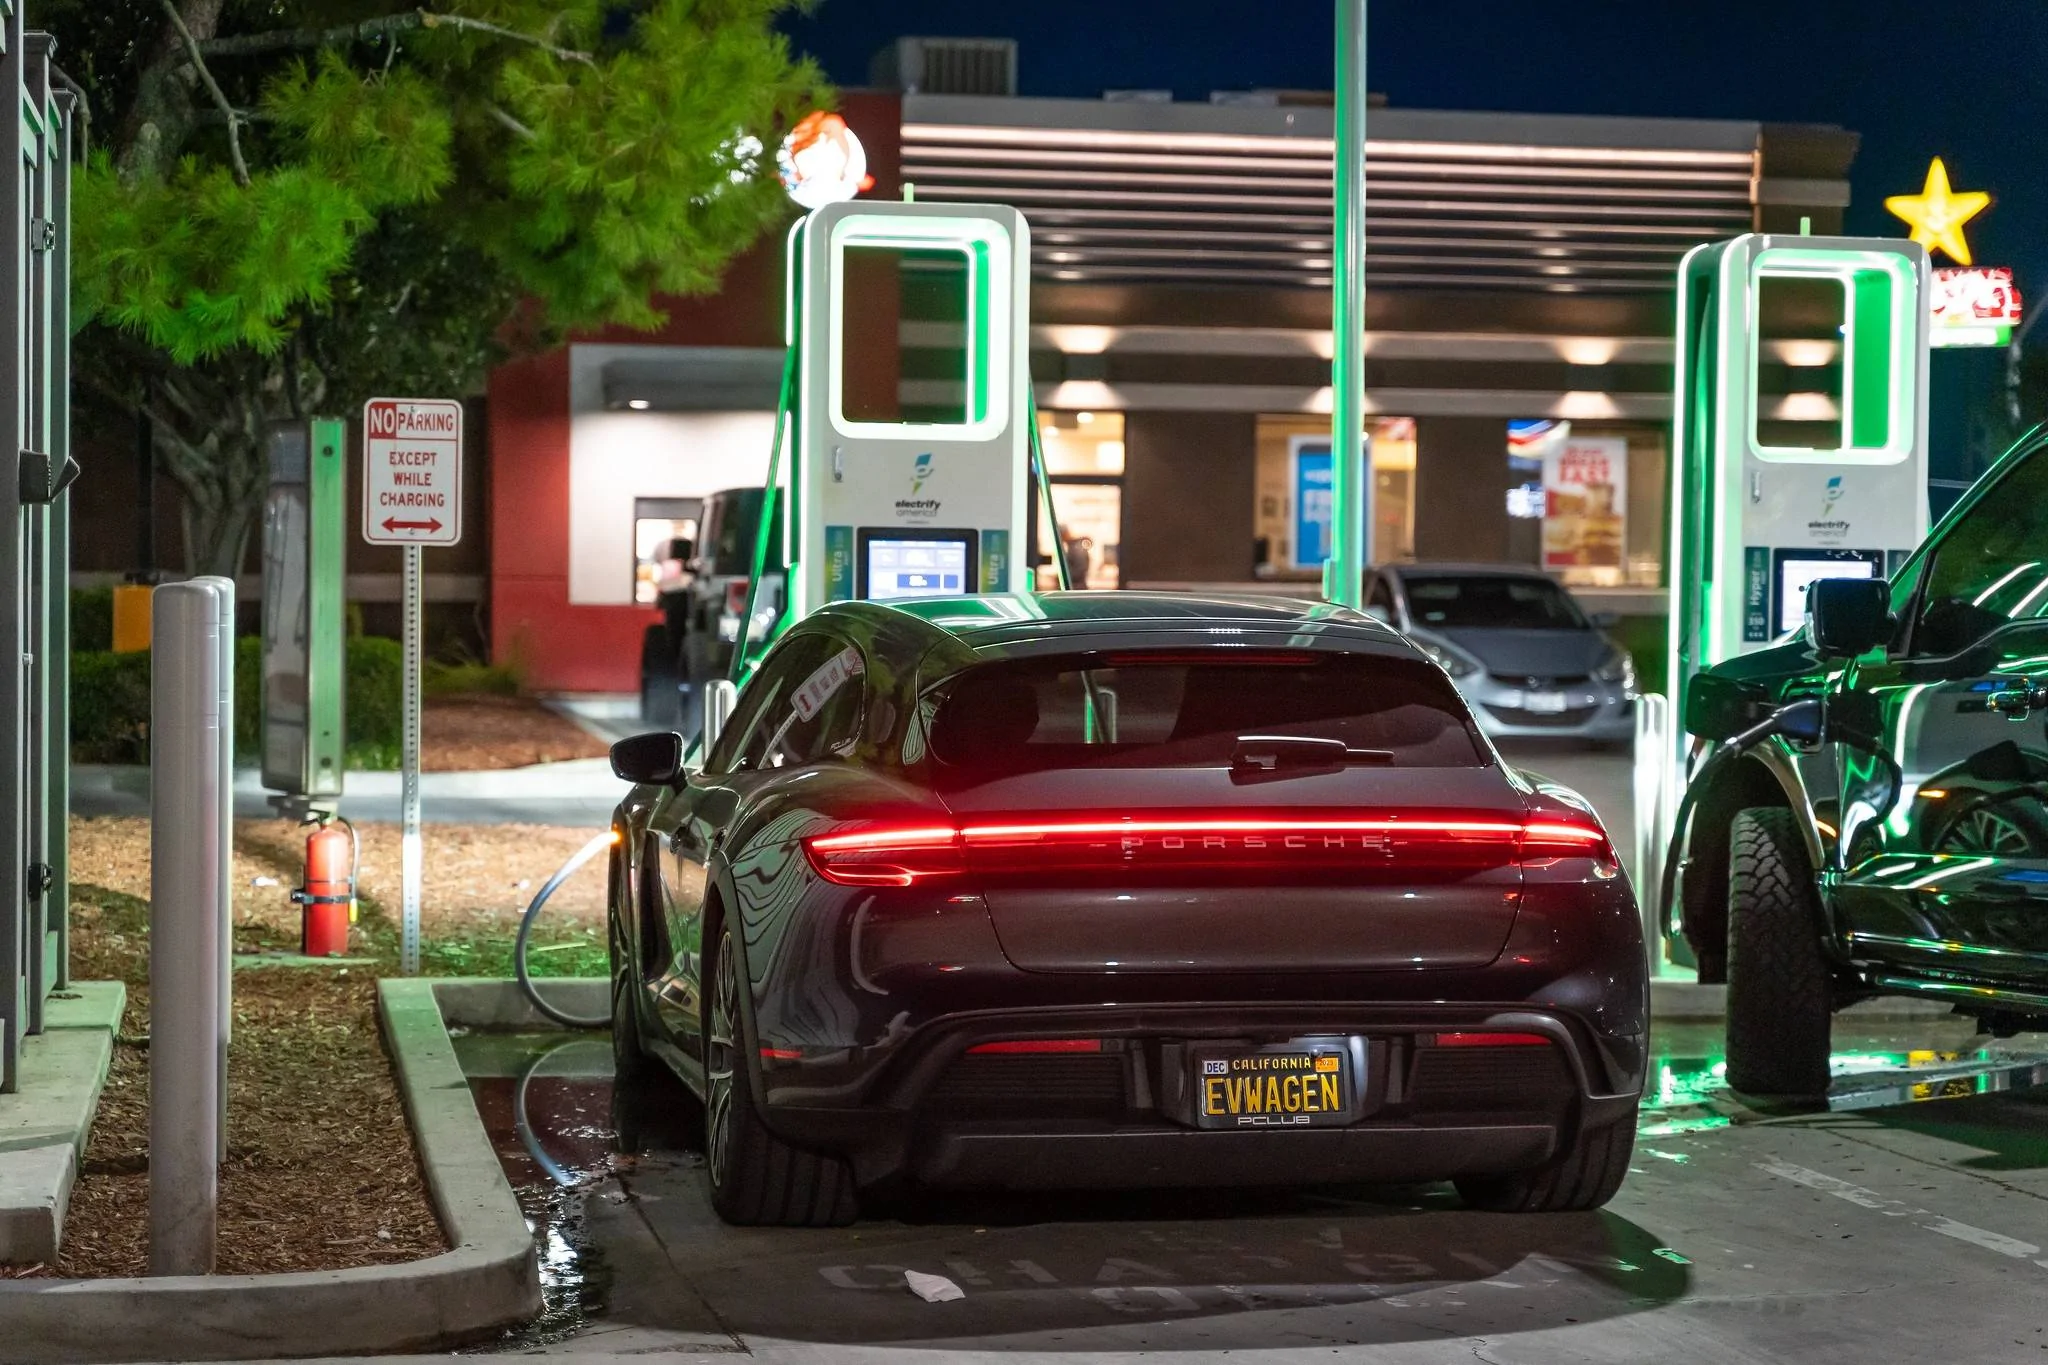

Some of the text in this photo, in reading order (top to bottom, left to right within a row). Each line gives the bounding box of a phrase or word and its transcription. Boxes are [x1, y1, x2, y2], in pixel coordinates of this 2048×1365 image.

[370, 407, 454, 434] NO PARKING
[389, 451, 438, 466] EXCEPT
[393, 472, 432, 487] WHILE
[379, 492, 445, 507] CHARGING
[895, 499, 941, 511] electrify
[1808, 520, 1850, 530] electrify
[1121, 835, 1385, 850] PORSCHE
[1206, 1062, 1226, 1073] DEC
[1232, 1057, 1312, 1071] CALIFORNIA
[1205, 1074, 1340, 1116] EVWAGEN
[1237, 1115, 1311, 1126] PCLUB
